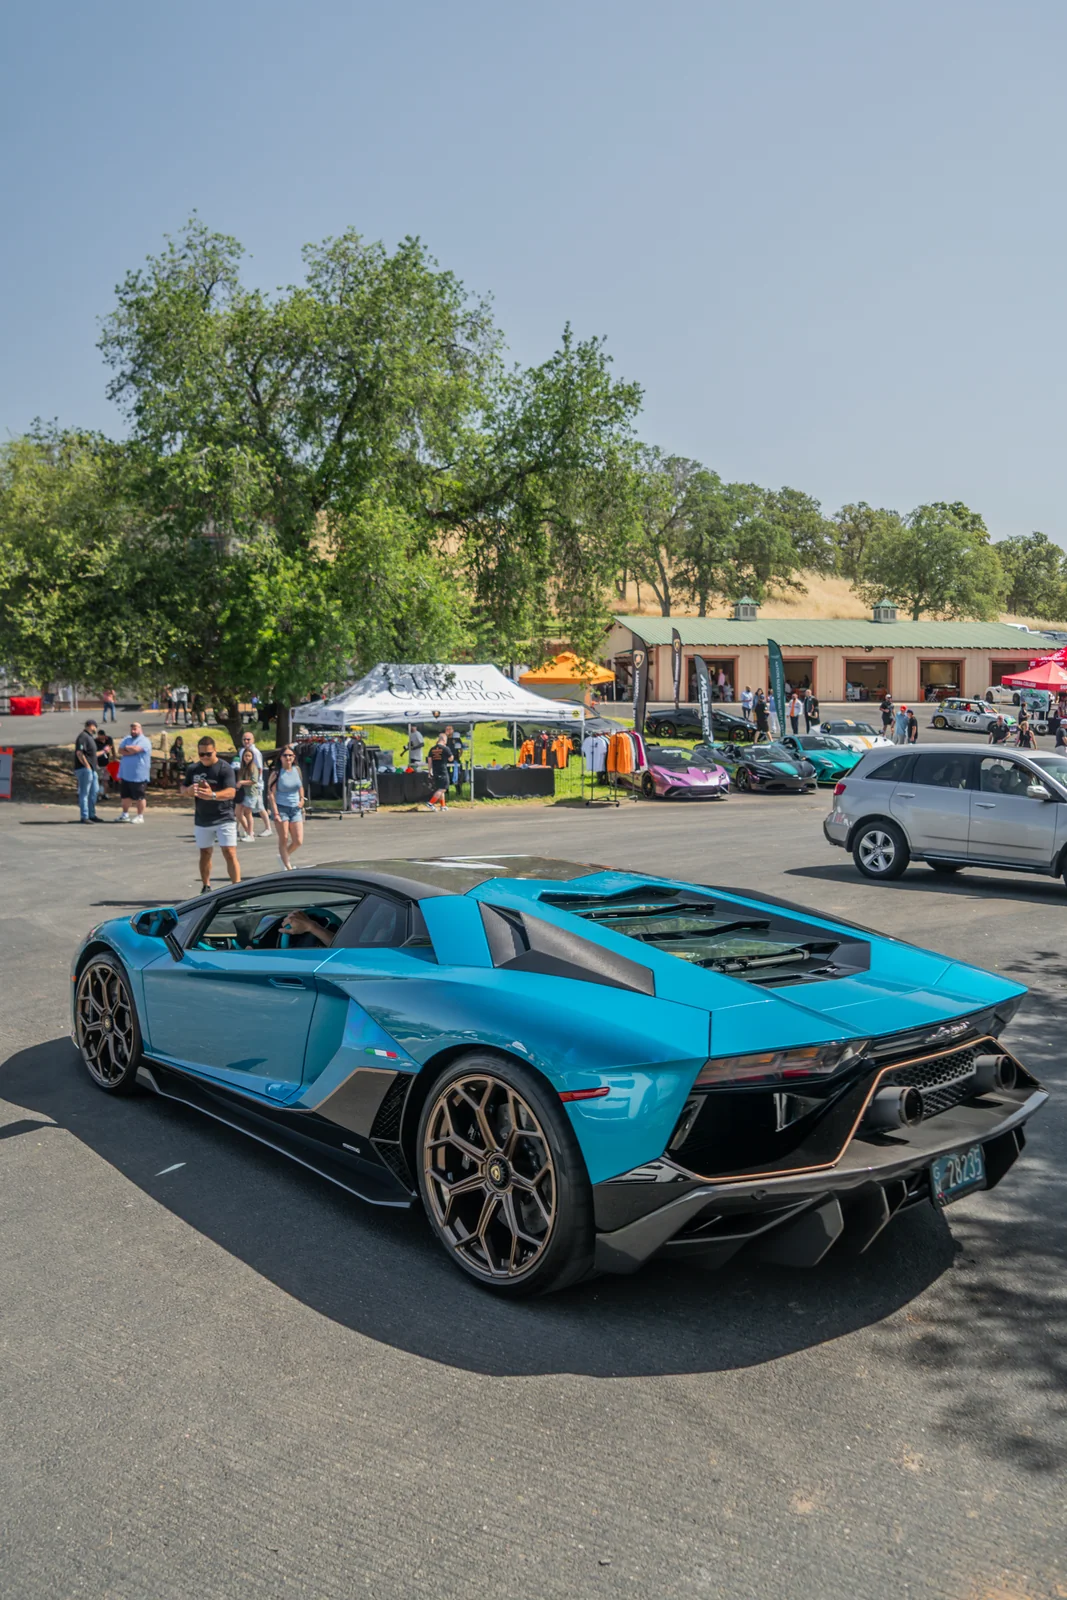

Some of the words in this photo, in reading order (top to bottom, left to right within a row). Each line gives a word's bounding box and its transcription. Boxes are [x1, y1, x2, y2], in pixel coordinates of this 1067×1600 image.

[402, 672, 485, 691] LUURY
[388, 684, 515, 701] COLLECTION
[964, 715, 977, 724] 115
[947, 1149, 982, 1188] 28235
